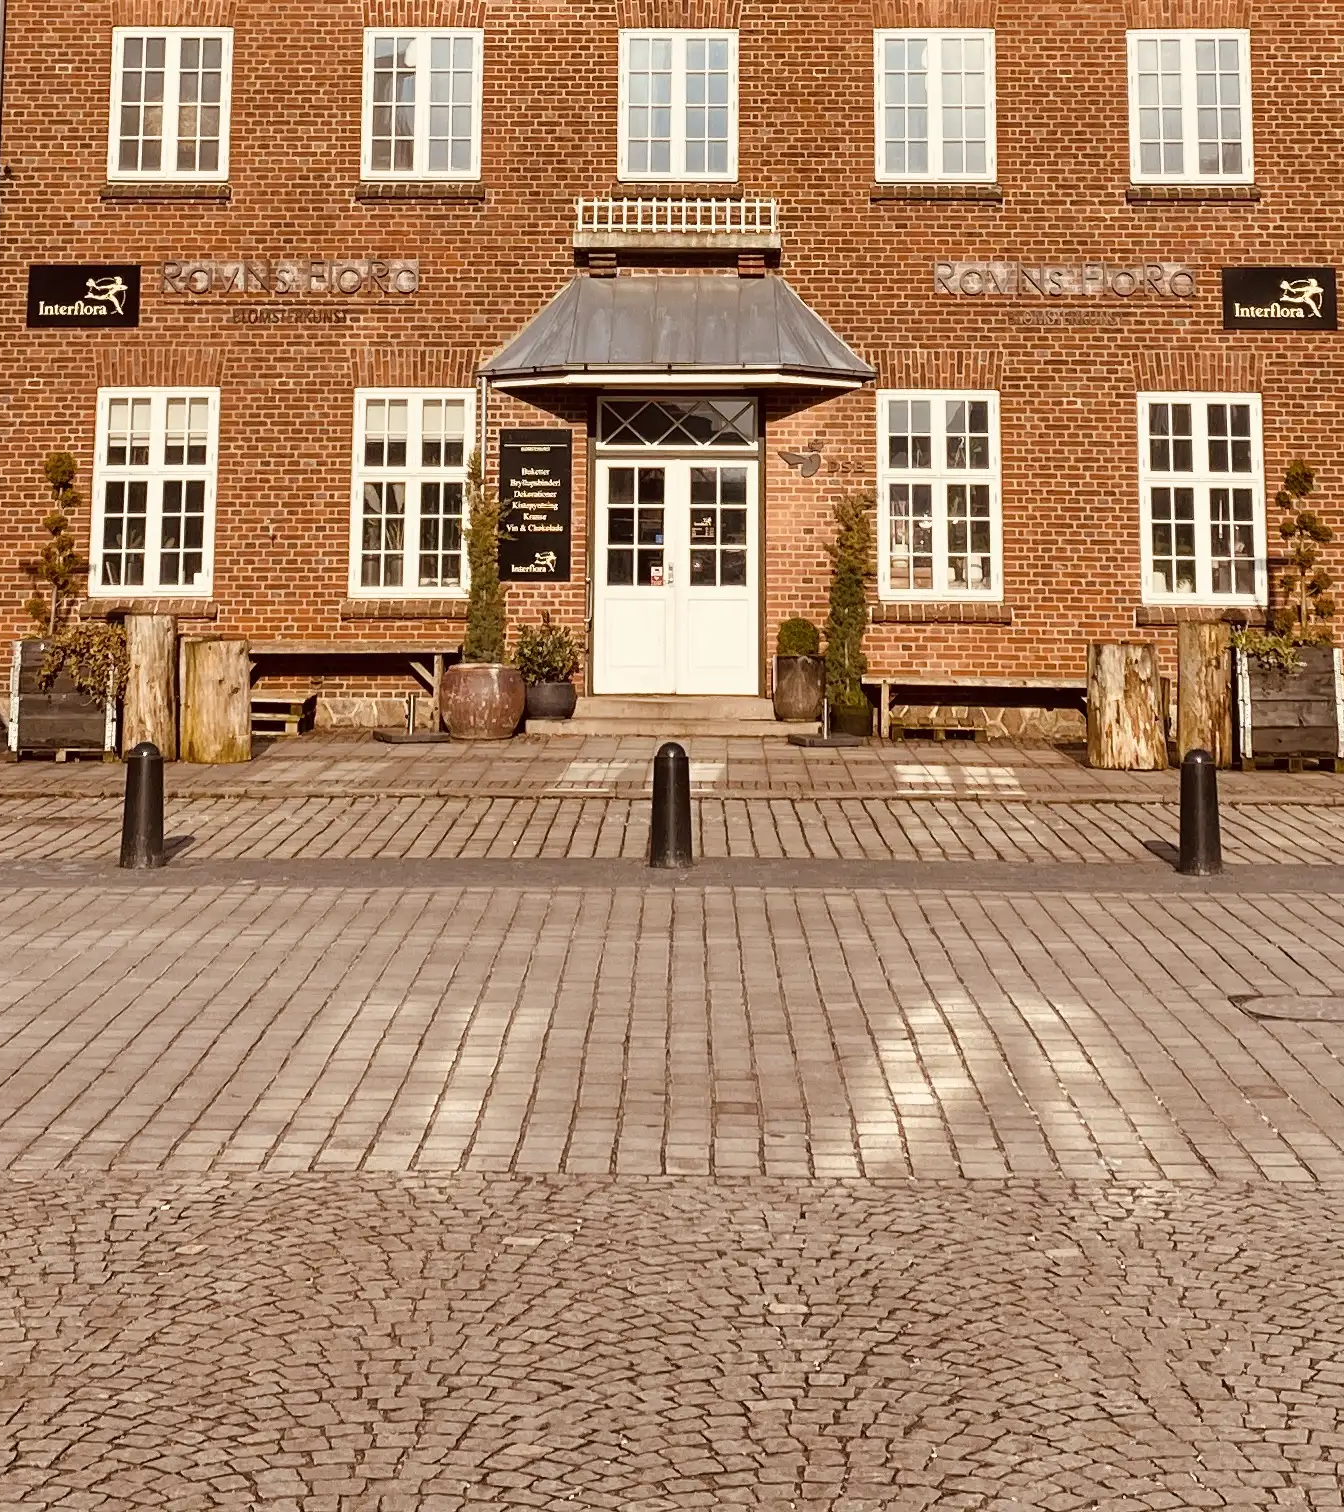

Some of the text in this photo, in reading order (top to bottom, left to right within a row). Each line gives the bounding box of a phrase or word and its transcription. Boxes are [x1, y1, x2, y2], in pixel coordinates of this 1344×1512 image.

[38, 300, 108, 316] Interflora
[1234, 302, 1305, 318] Interflora
[232, 308, 349, 325] BLOMSTERKUNST
[506, 523, 564, 532] Vin & Chokolade
[511, 563, 547, 573] Interflora
